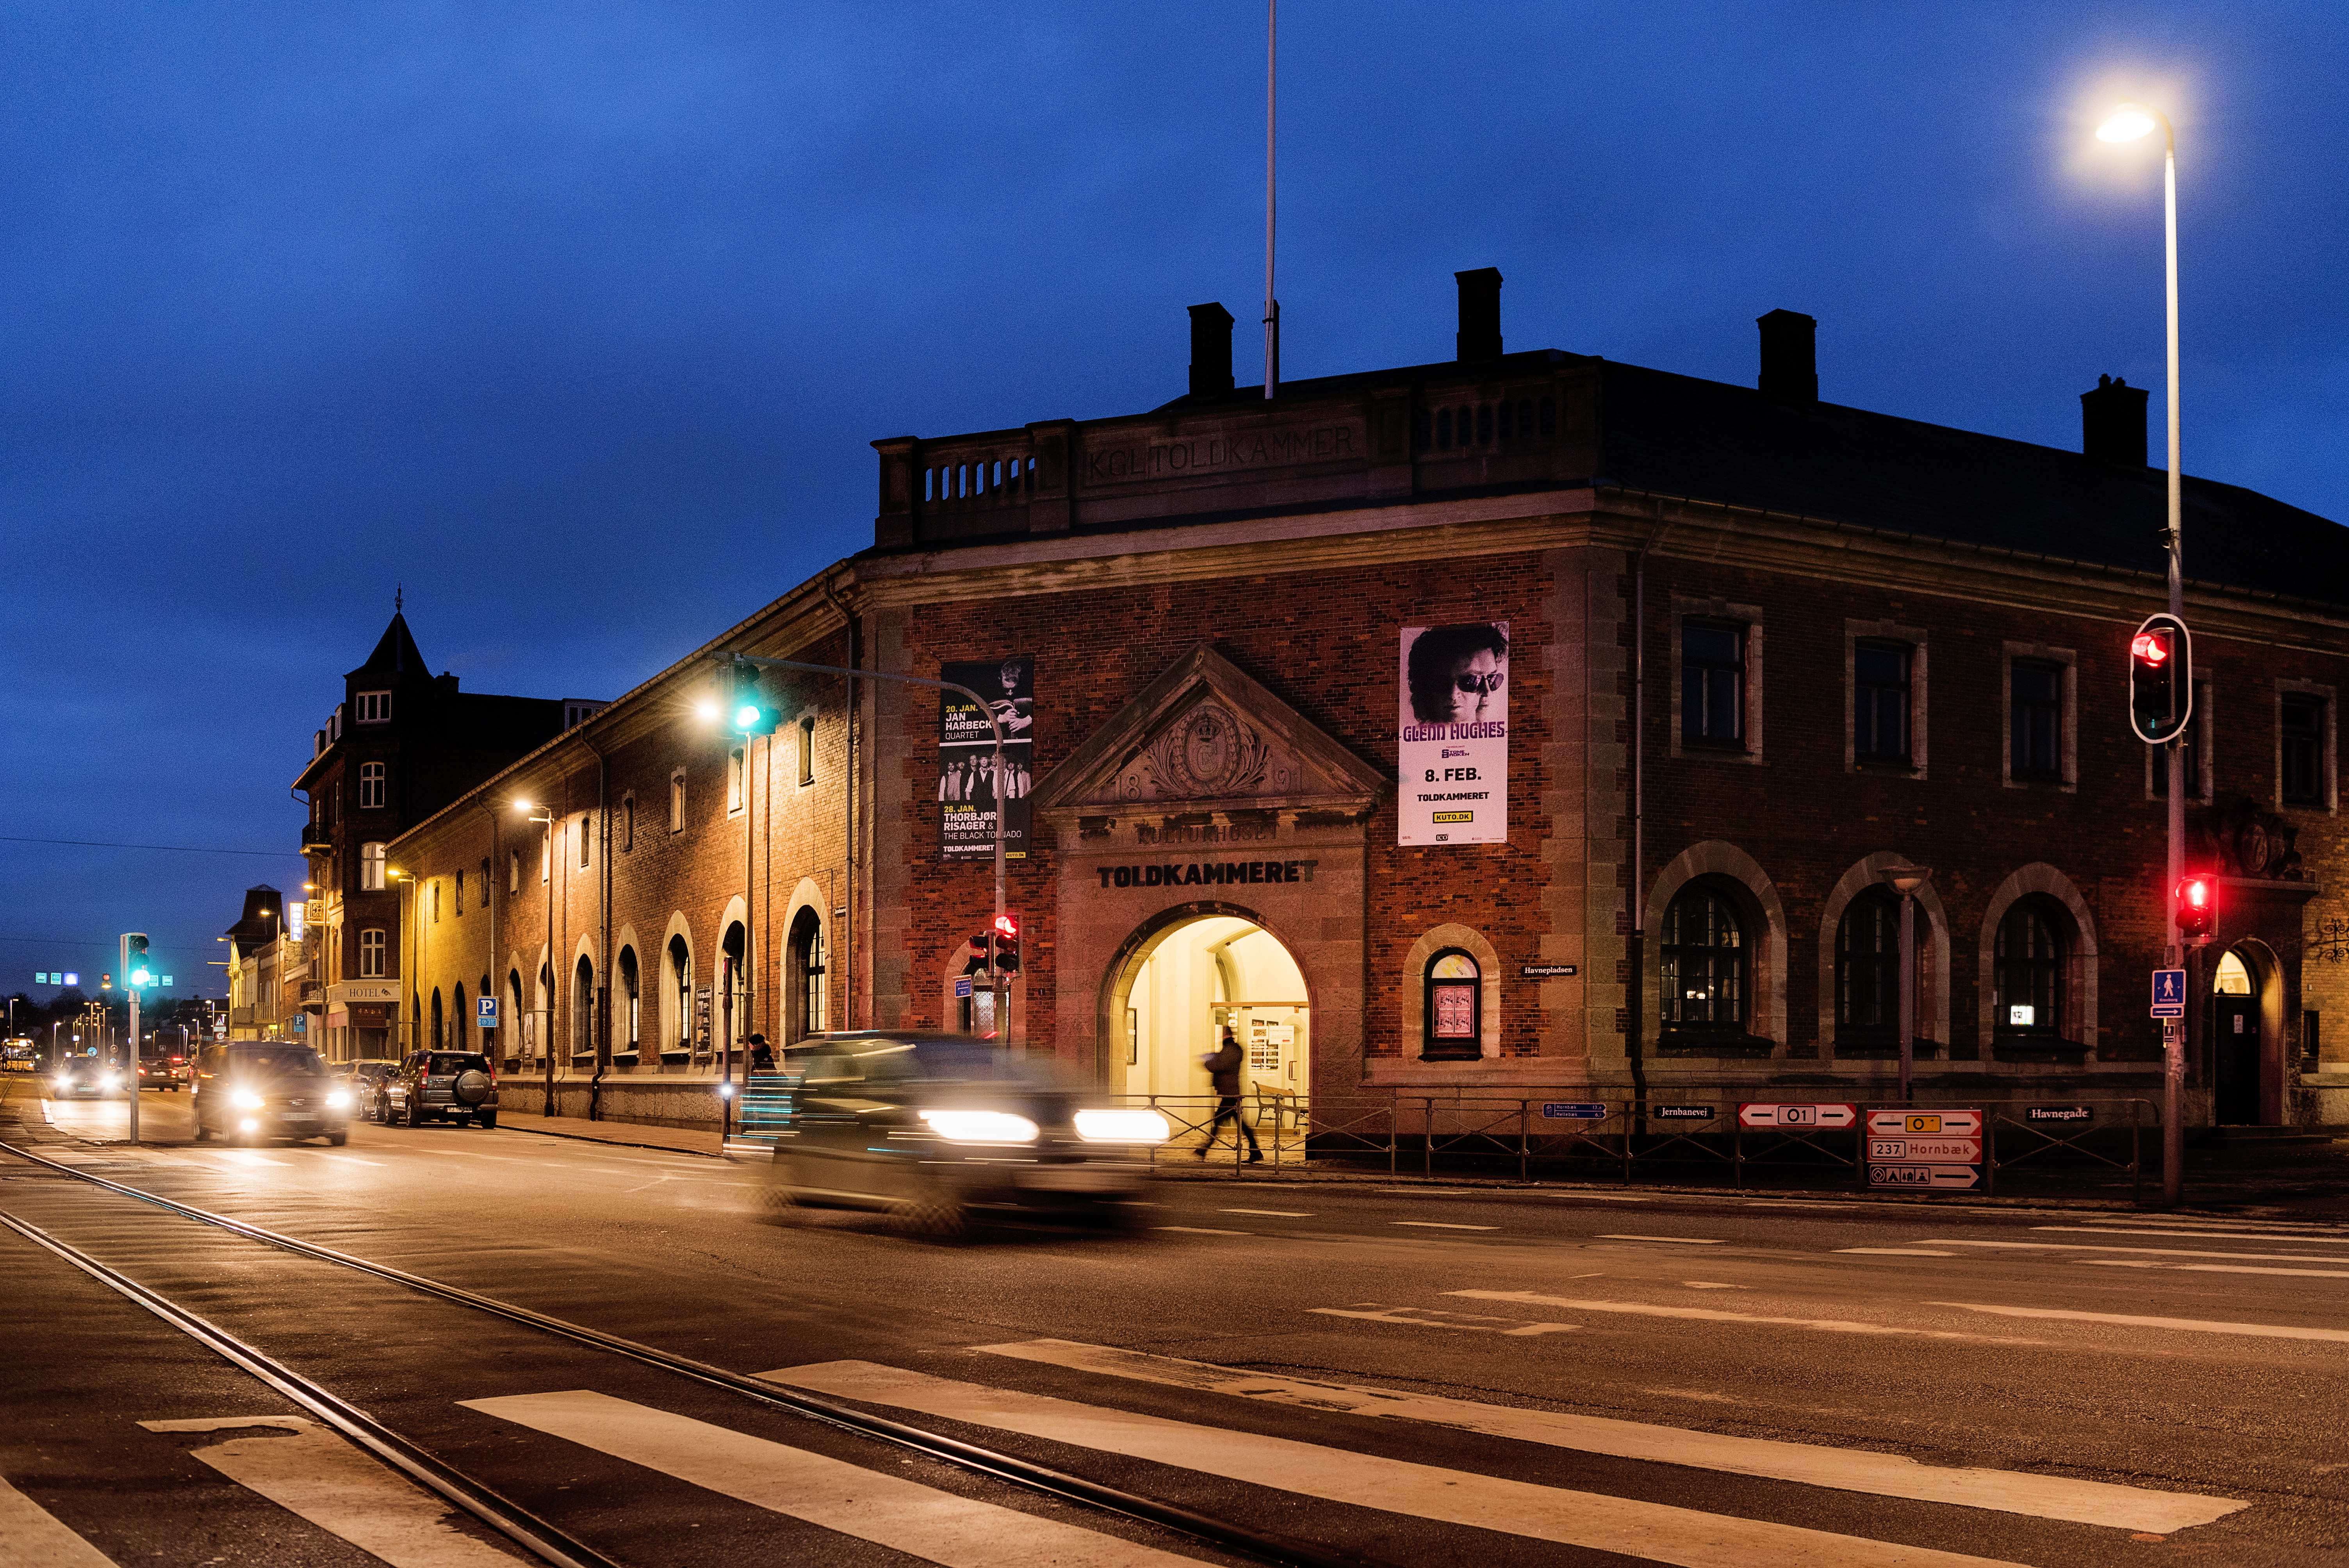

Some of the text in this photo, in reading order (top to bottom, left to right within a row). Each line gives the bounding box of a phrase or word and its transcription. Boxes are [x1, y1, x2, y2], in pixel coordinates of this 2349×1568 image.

[1148, 426, 1355, 472] TOLDKAMMER
[959, 704, 978, 712] JAN.
[946, 712, 966, 722] JAN
[945, 720, 993, 731] HARBECK
[945, 731, 979, 740] QUARTET
[1403, 721, 1505, 742] GLENN HUGHES
[1425, 767, 1481, 782] 8. FEB.
[1417, 791, 1490, 802] TOLDKAMMERET
[944, 812, 996, 822] THORBJØR
[1436, 813, 1469, 821] KUTO.DK
[944, 821, 986, 831] RISAGER
[960, 831, 984, 839] BLACK
[986, 830, 1022, 839] TOADO
[1137, 823, 1280, 845] KULTURHUSET
[943, 844, 994, 852] TOLDKAMMERET
[1096, 860, 1319, 888] TOLDKAMMERET
[1524, 966, 1573, 975] Havnepladsen
[349, 988, 380, 997] HOTEL
[481, 1000, 494, 1014] P
[296, 1016, 303, 1025] P
[1661, 1107, 1708, 1118] Jernbanevej
[1787, 1108, 1806, 1122] O1
[2032, 1108, 2088, 1120] Havnegade
[1877, 1143, 1970, 1155] 237 Hornbæk
